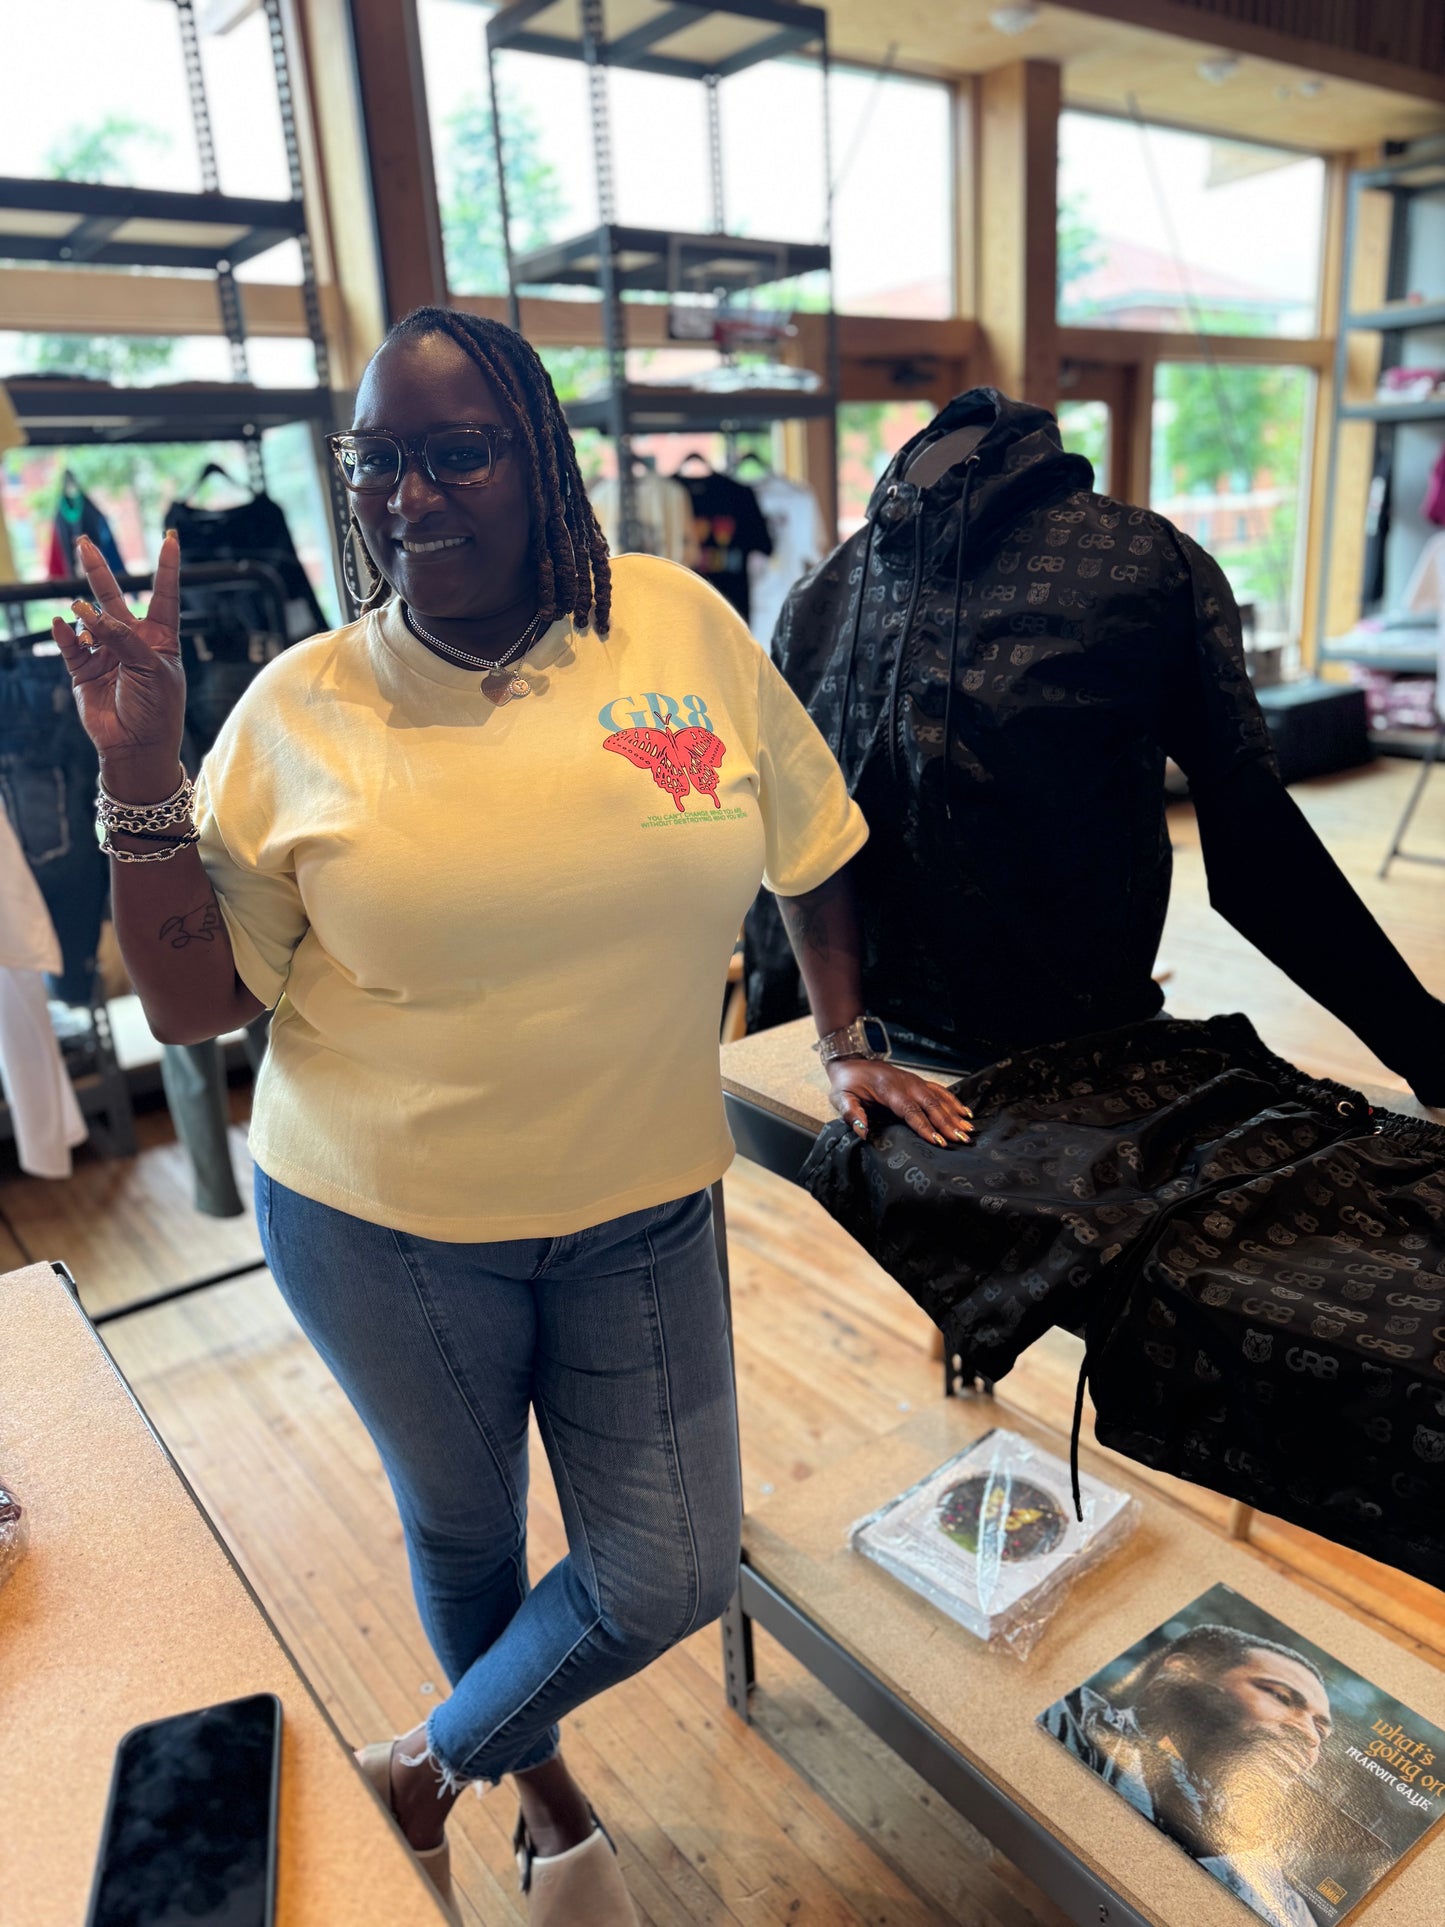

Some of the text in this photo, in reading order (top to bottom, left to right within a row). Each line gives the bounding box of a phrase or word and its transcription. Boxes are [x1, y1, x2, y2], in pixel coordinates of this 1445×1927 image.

[1048, 510, 1086, 524] GR8
[1078, 533, 1116, 549] GR8
[1027, 555, 1065, 573] GR8
[980, 585, 1016, 602] GR8
[1009, 615, 1048, 633] GR8
[598, 692, 714, 733] GR8
[641, 820, 672, 828] WITHOUT
[674, 816, 712, 825] DESTROYING
[684, 810, 708, 818] CHANGE
[1126, 1086, 1157, 1110] GR8
[904, 1166, 931, 1195] GR8
[1312, 1156, 1357, 1188] GR8
[1060, 1212, 1099, 1245] GR8
[1338, 1205, 1387, 1238] GR8
[1344, 1263, 1397, 1280] GR8
[1370, 1250, 1422, 1270] GR8
[1274, 1270, 1326, 1290] GR8
[1241, 1297, 1295, 1324] GR8
[1313, 1301, 1369, 1323] GR8
[1385, 1292, 1443, 1312] GR8
[1356, 1333, 1416, 1359] GR8
[1285, 1346, 1340, 1380] GR8
[1370, 1719, 1436, 1767] what's
[1345, 1746, 1433, 1812] MARVIN GAYE
[1363, 1739, 1445, 1798] going on
